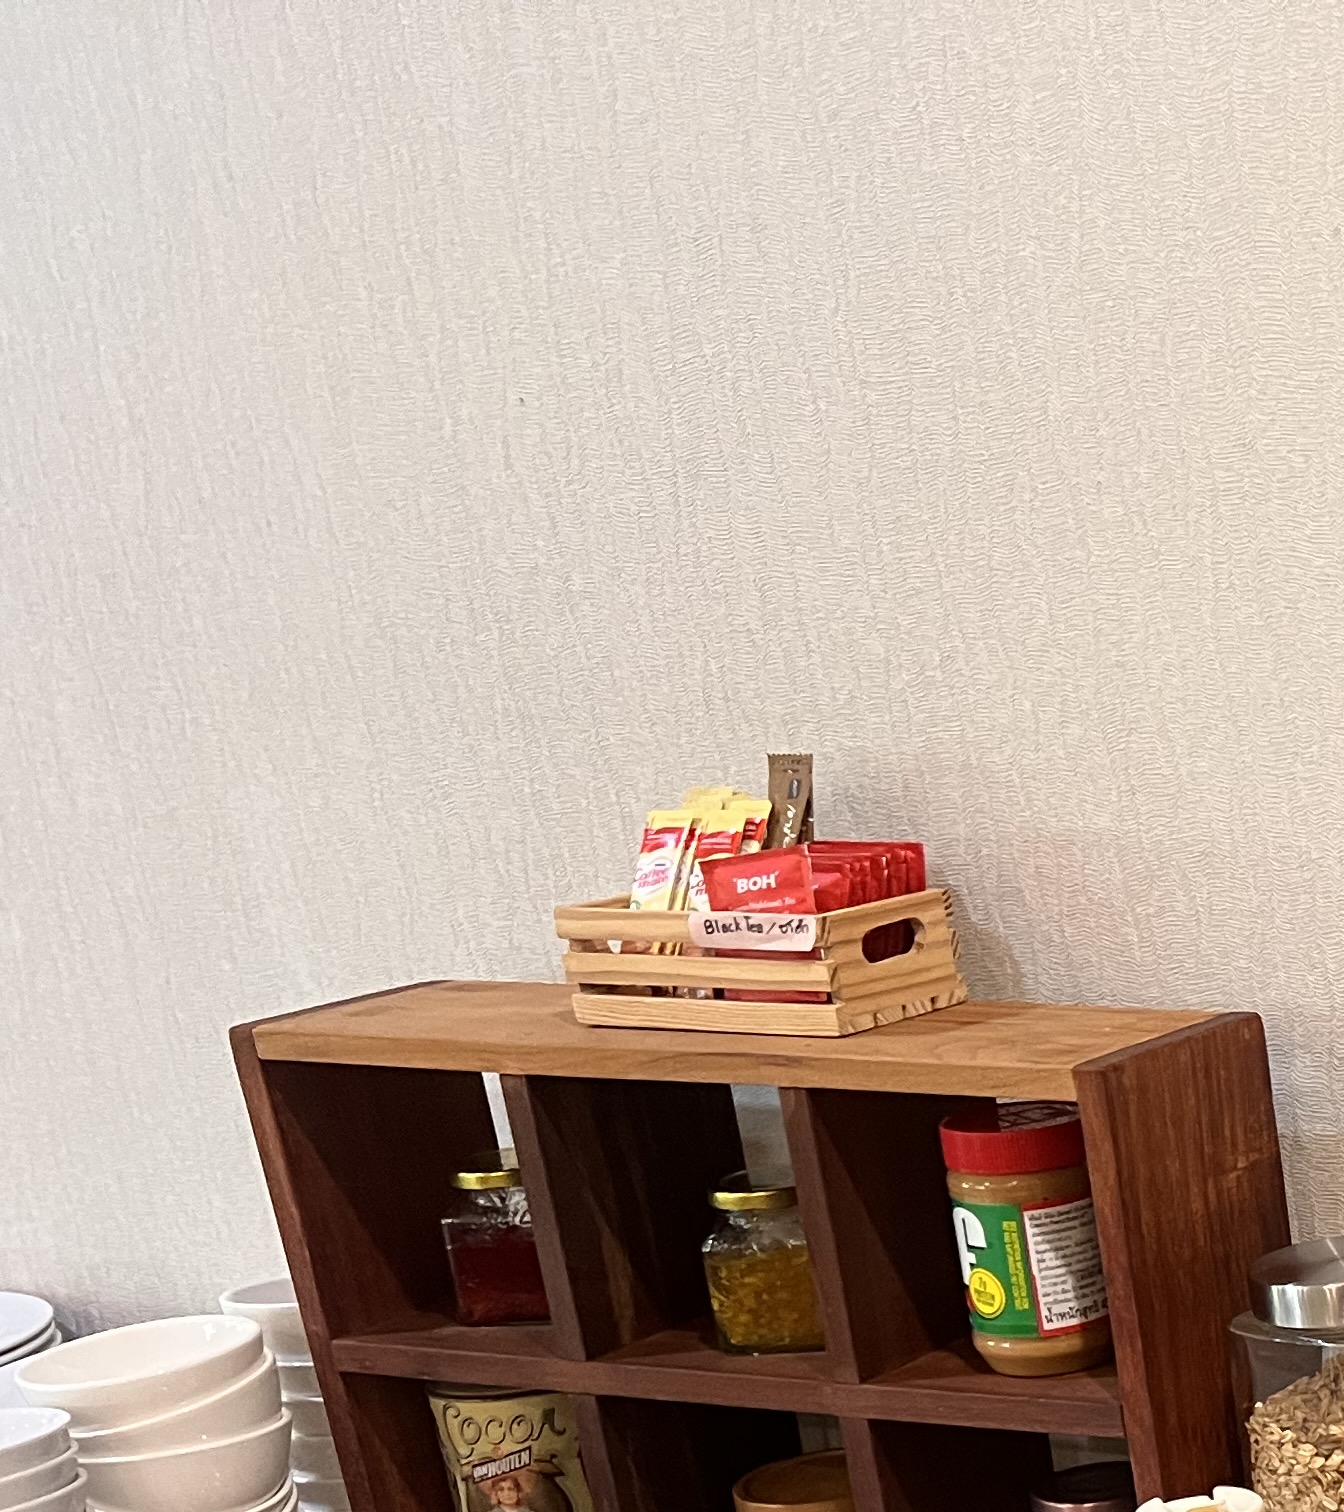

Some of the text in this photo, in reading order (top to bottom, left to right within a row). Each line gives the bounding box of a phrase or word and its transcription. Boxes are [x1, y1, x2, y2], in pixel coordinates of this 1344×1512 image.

[703, 916, 742, 935] Black
[743, 915, 764, 934] Tea
[488, 1448, 531, 1478] HOUTEN
